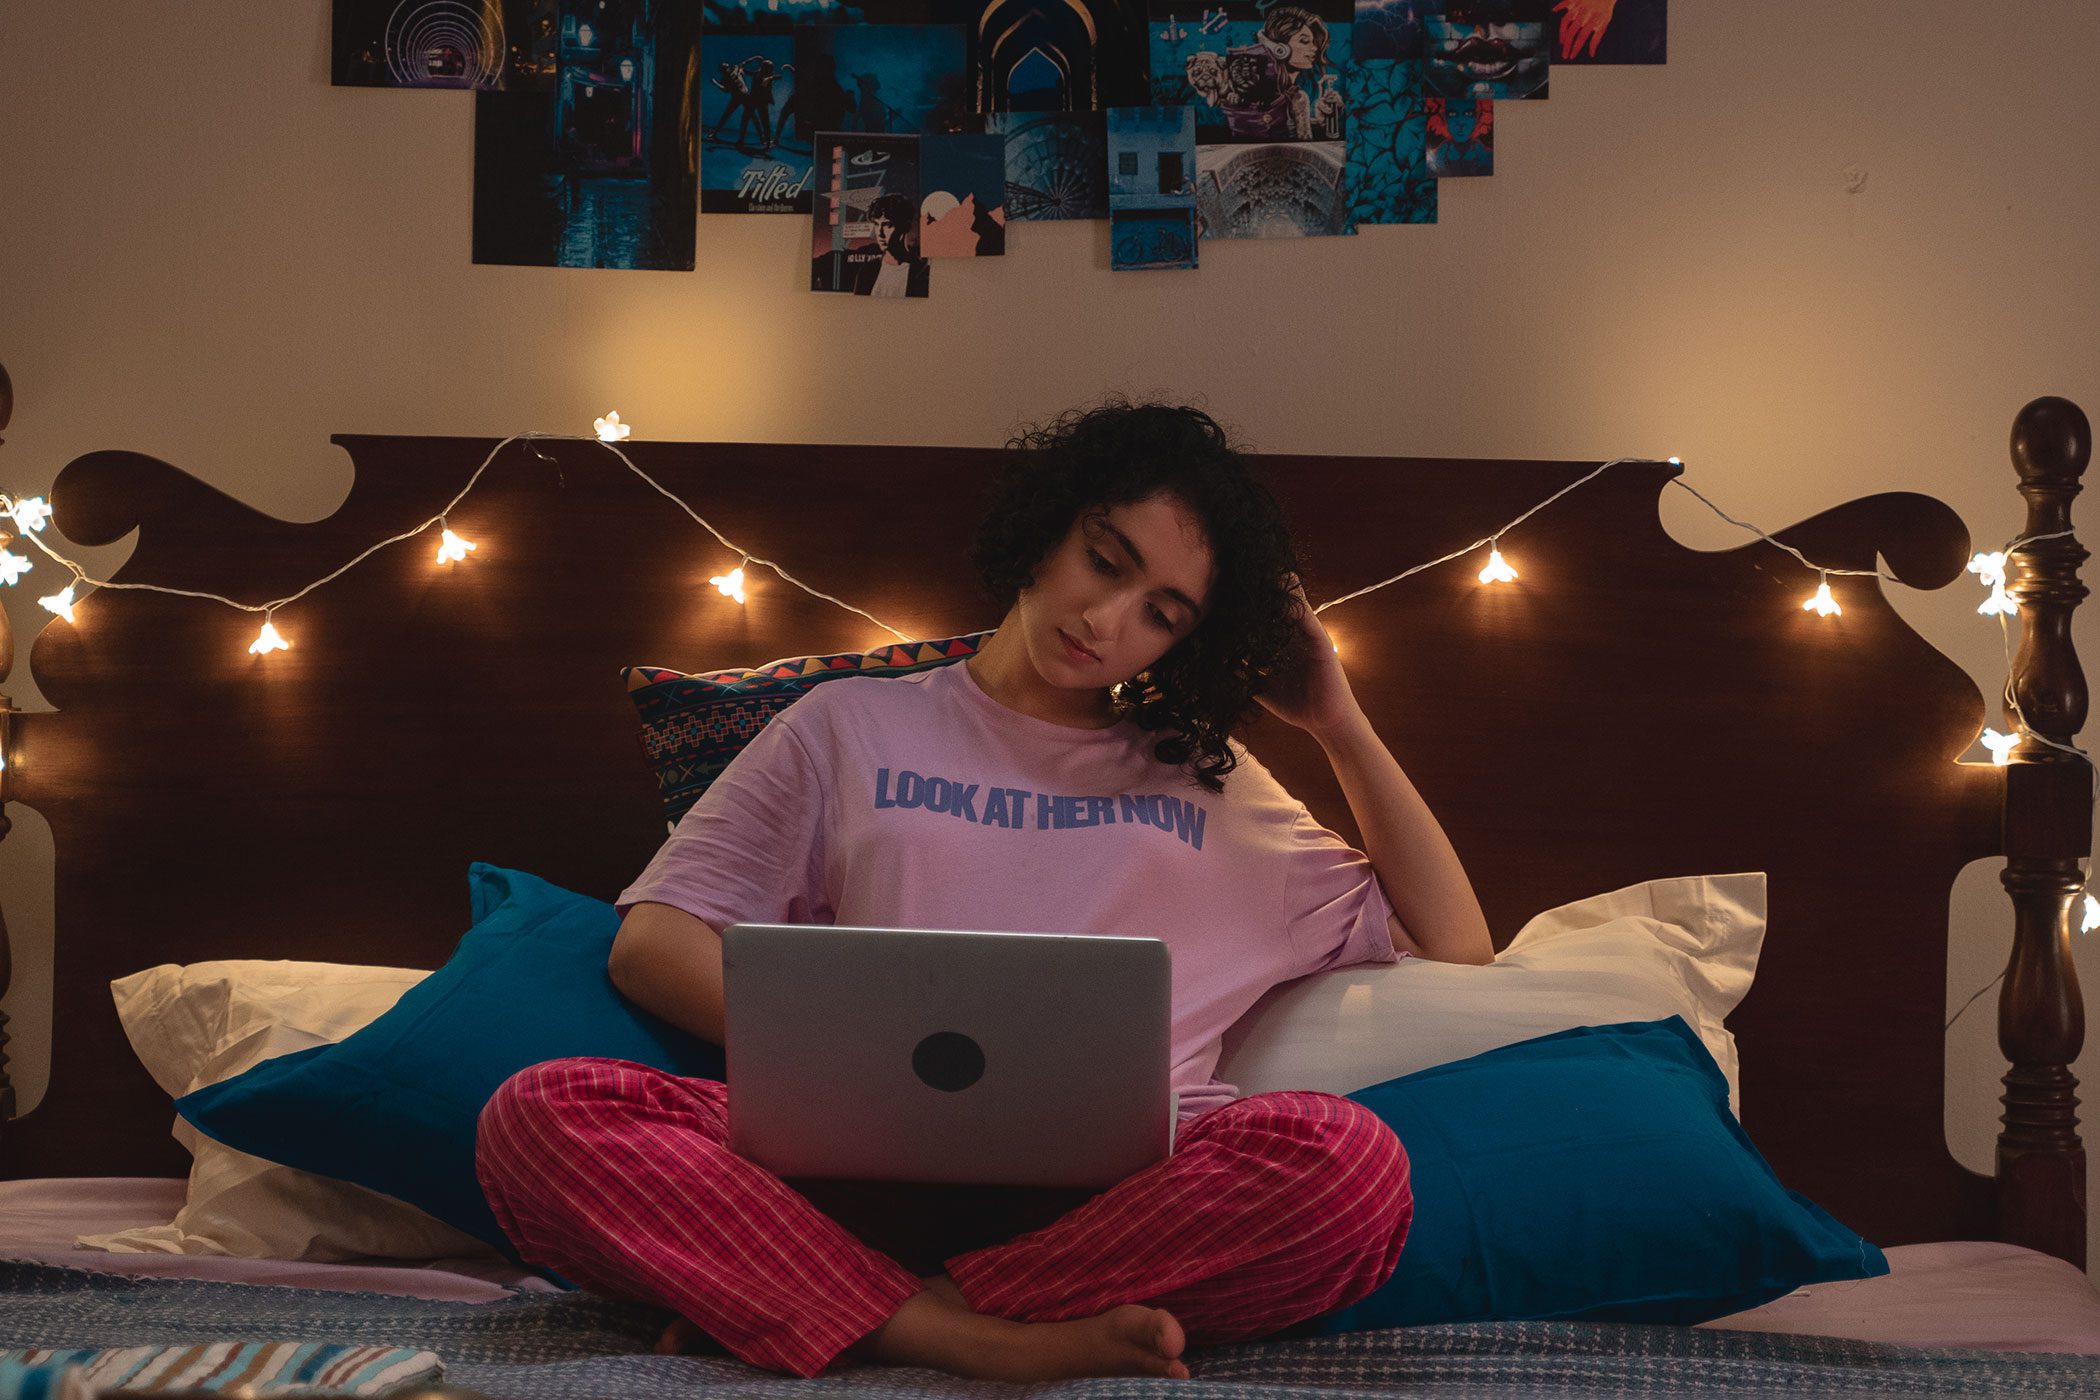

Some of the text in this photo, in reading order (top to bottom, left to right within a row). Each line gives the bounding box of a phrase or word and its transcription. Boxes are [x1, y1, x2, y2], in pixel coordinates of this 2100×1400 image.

[738, 165, 814, 203] Tilted
[874, 768, 1207, 851] LOOK AT HER NOW
